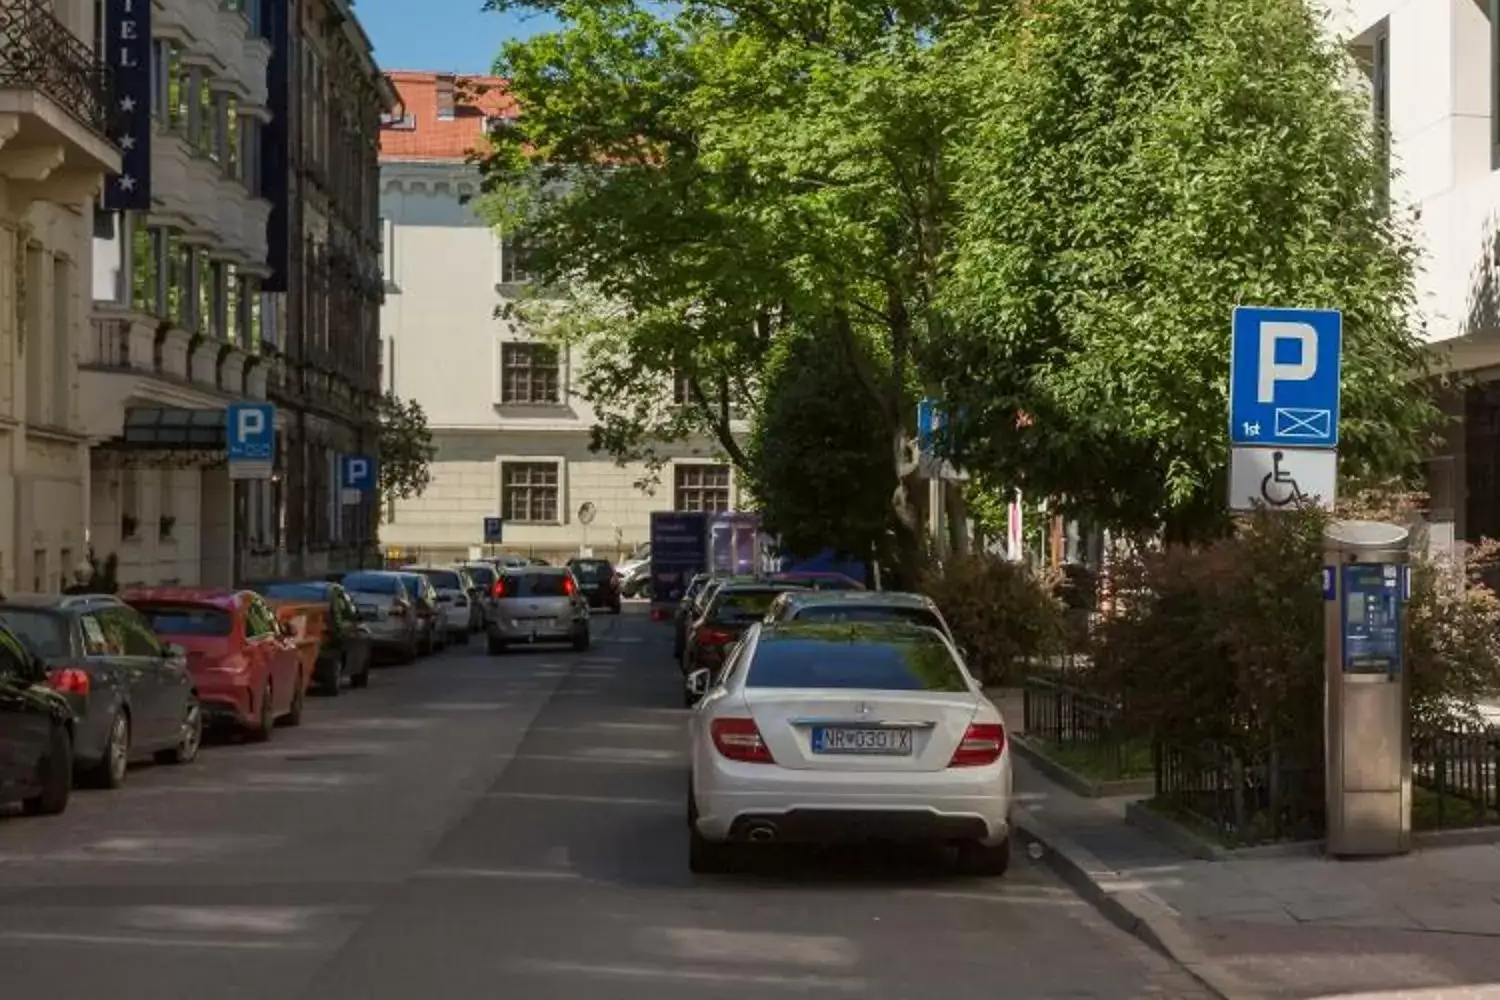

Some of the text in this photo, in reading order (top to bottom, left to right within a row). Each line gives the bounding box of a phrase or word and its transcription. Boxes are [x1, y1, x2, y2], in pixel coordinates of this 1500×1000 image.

[1258, 321, 1318, 402] P
[237, 408, 265, 443] P
[348, 459, 368, 484] P
